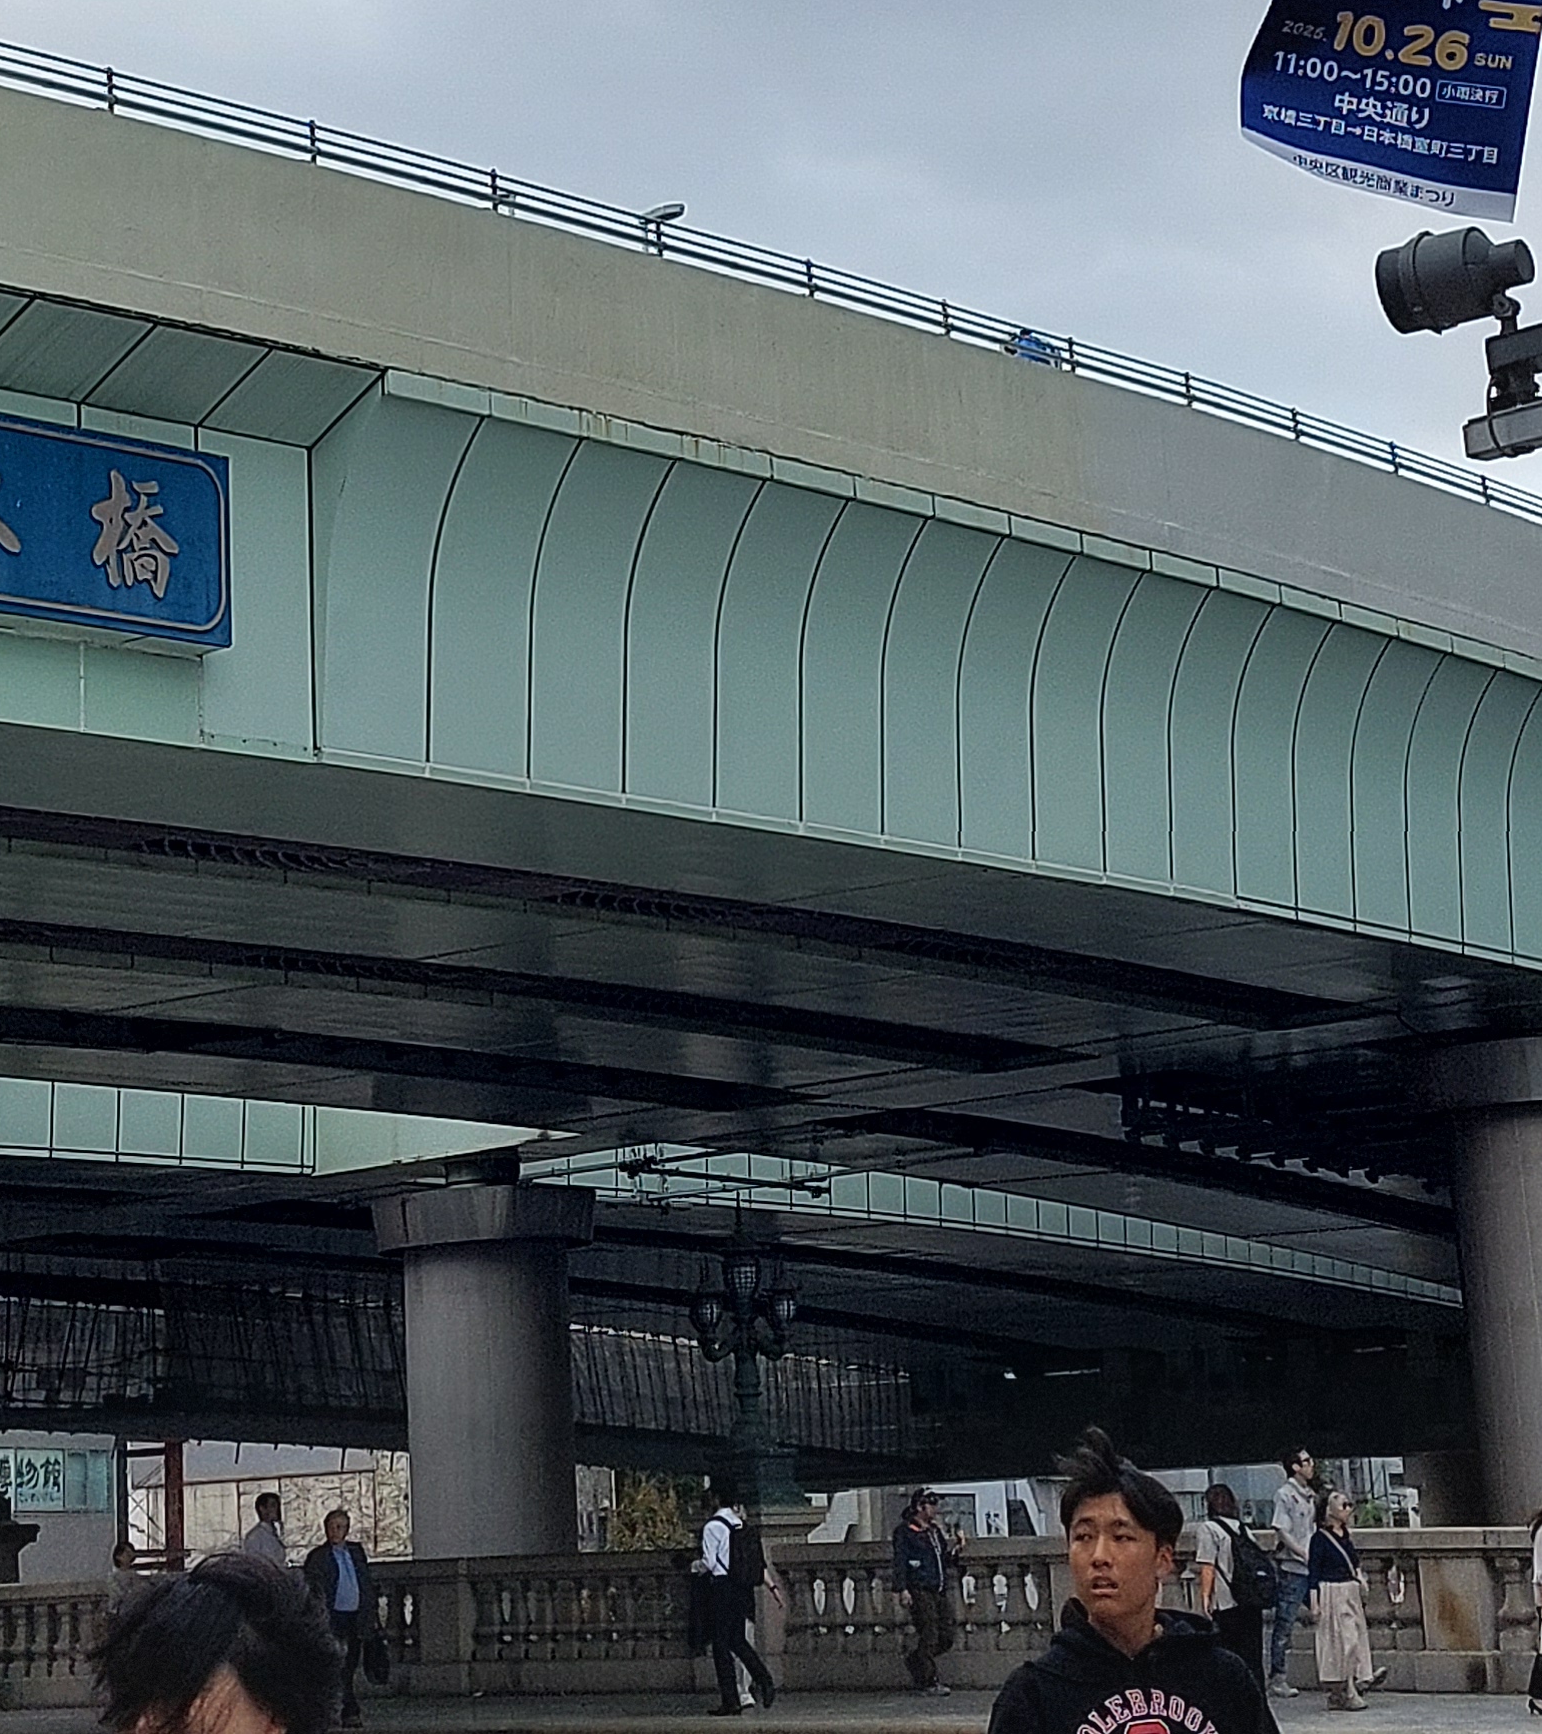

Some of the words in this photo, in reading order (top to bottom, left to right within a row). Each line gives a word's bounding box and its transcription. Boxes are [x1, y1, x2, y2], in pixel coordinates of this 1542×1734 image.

[1332, 10, 1471, 71] 10.26
[1473, 52, 1513, 70] SUN
[1333, 91, 1430, 130] 中央通り
